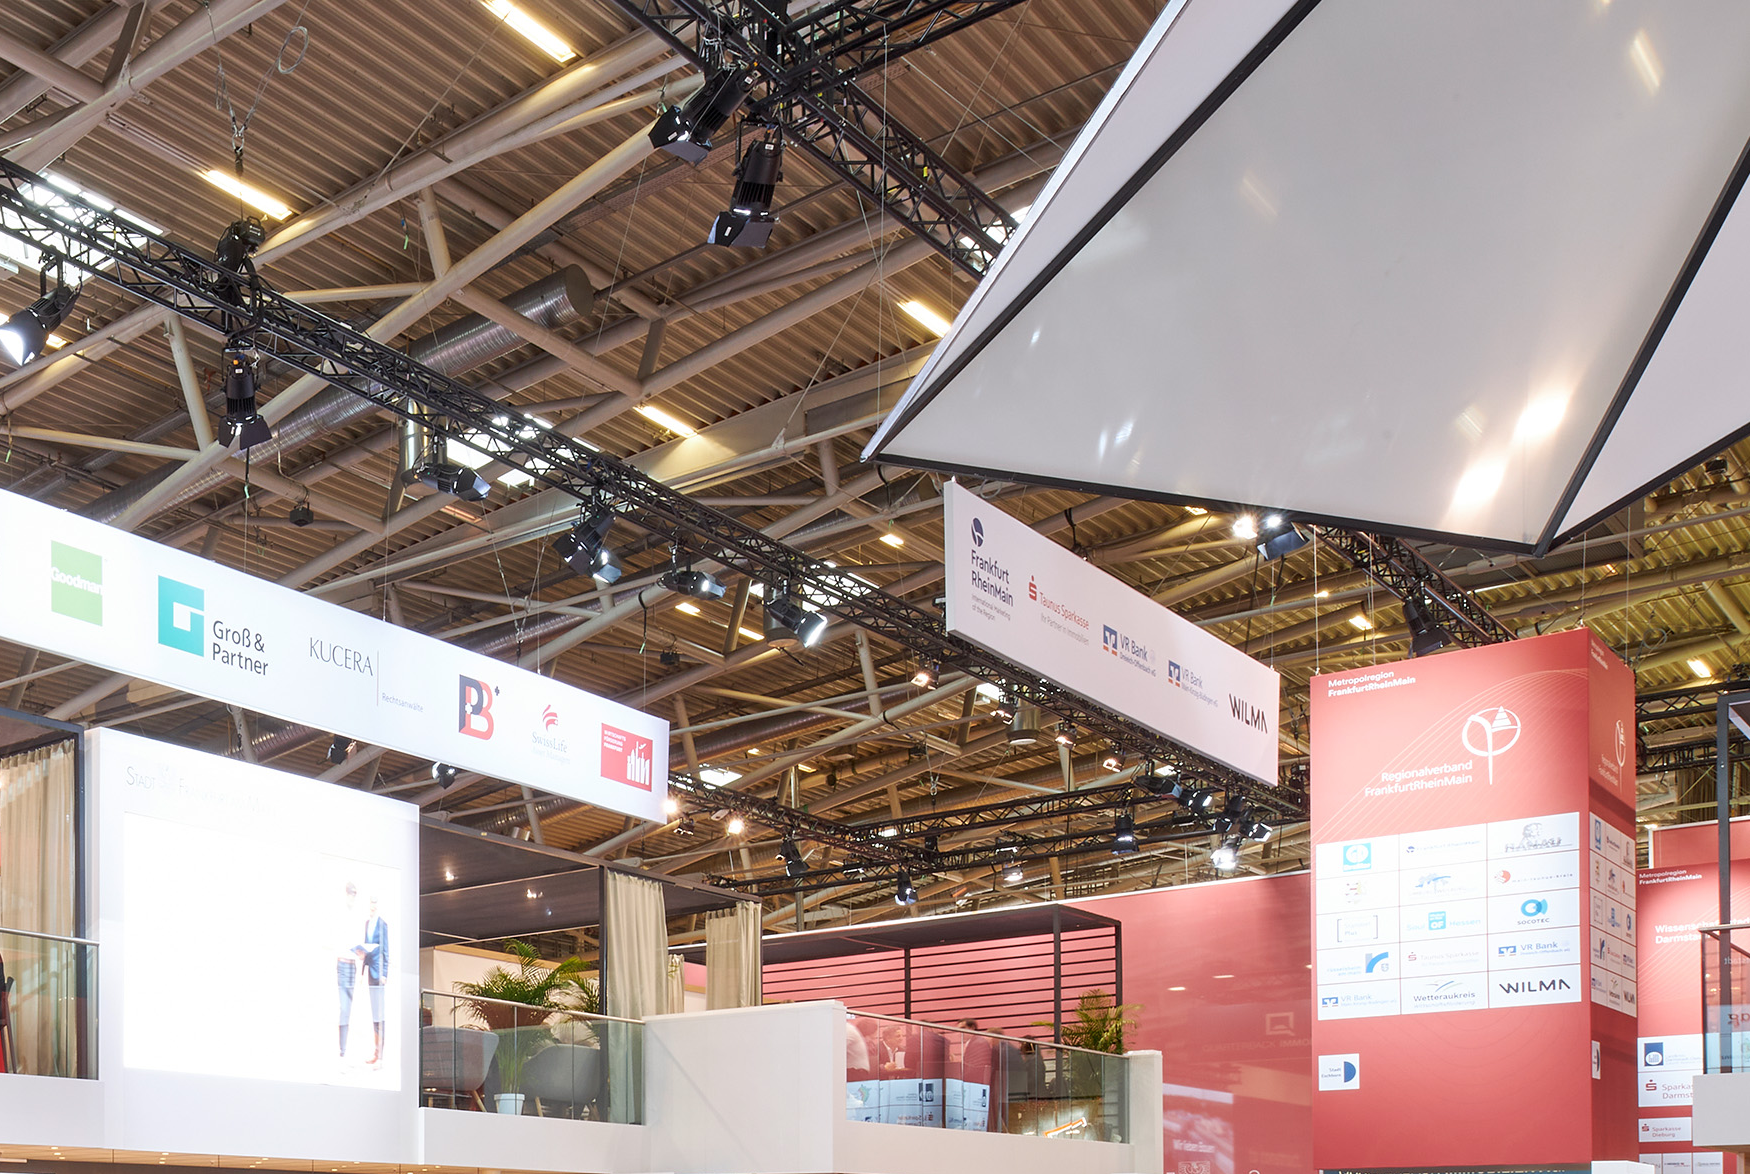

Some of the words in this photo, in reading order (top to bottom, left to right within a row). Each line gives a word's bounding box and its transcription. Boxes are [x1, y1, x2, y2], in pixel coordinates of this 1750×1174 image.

[971, 549, 1009, 584] Frankfurt
[971, 570, 1013, 607] RheinMain
[1040, 592, 1060, 614] Taunus
[1061, 604, 1089, 630] Sparkasse
[213, 620, 250, 648] Groß
[255, 633, 265, 653] &
[1120, 634, 1130, 653] VR
[1131, 640, 1148, 662] Bank
[212, 642, 269, 676] Partner
[310, 637, 374, 677] KUCERA
[1181, 667, 1189, 681] VR
[1190, 671, 1203, 689] Bank
[1328, 670, 1394, 688] Metropolregion
[1328, 676, 1416, 697] FrankfurtRheinMain
[1381, 760, 1472, 784] Regionalverband
[1365, 773, 1472, 797] FrankfurtRheinMain
[1639, 869, 1687, 879] Metropolregion
[1517, 917, 1550, 925] SOCOTEC
[1520, 942, 1532, 951] VR
[1535, 940, 1558, 950] Bank
[1413, 992, 1476, 1002] Wetteraukreis
[1499, 978, 1571, 994] WILMA
